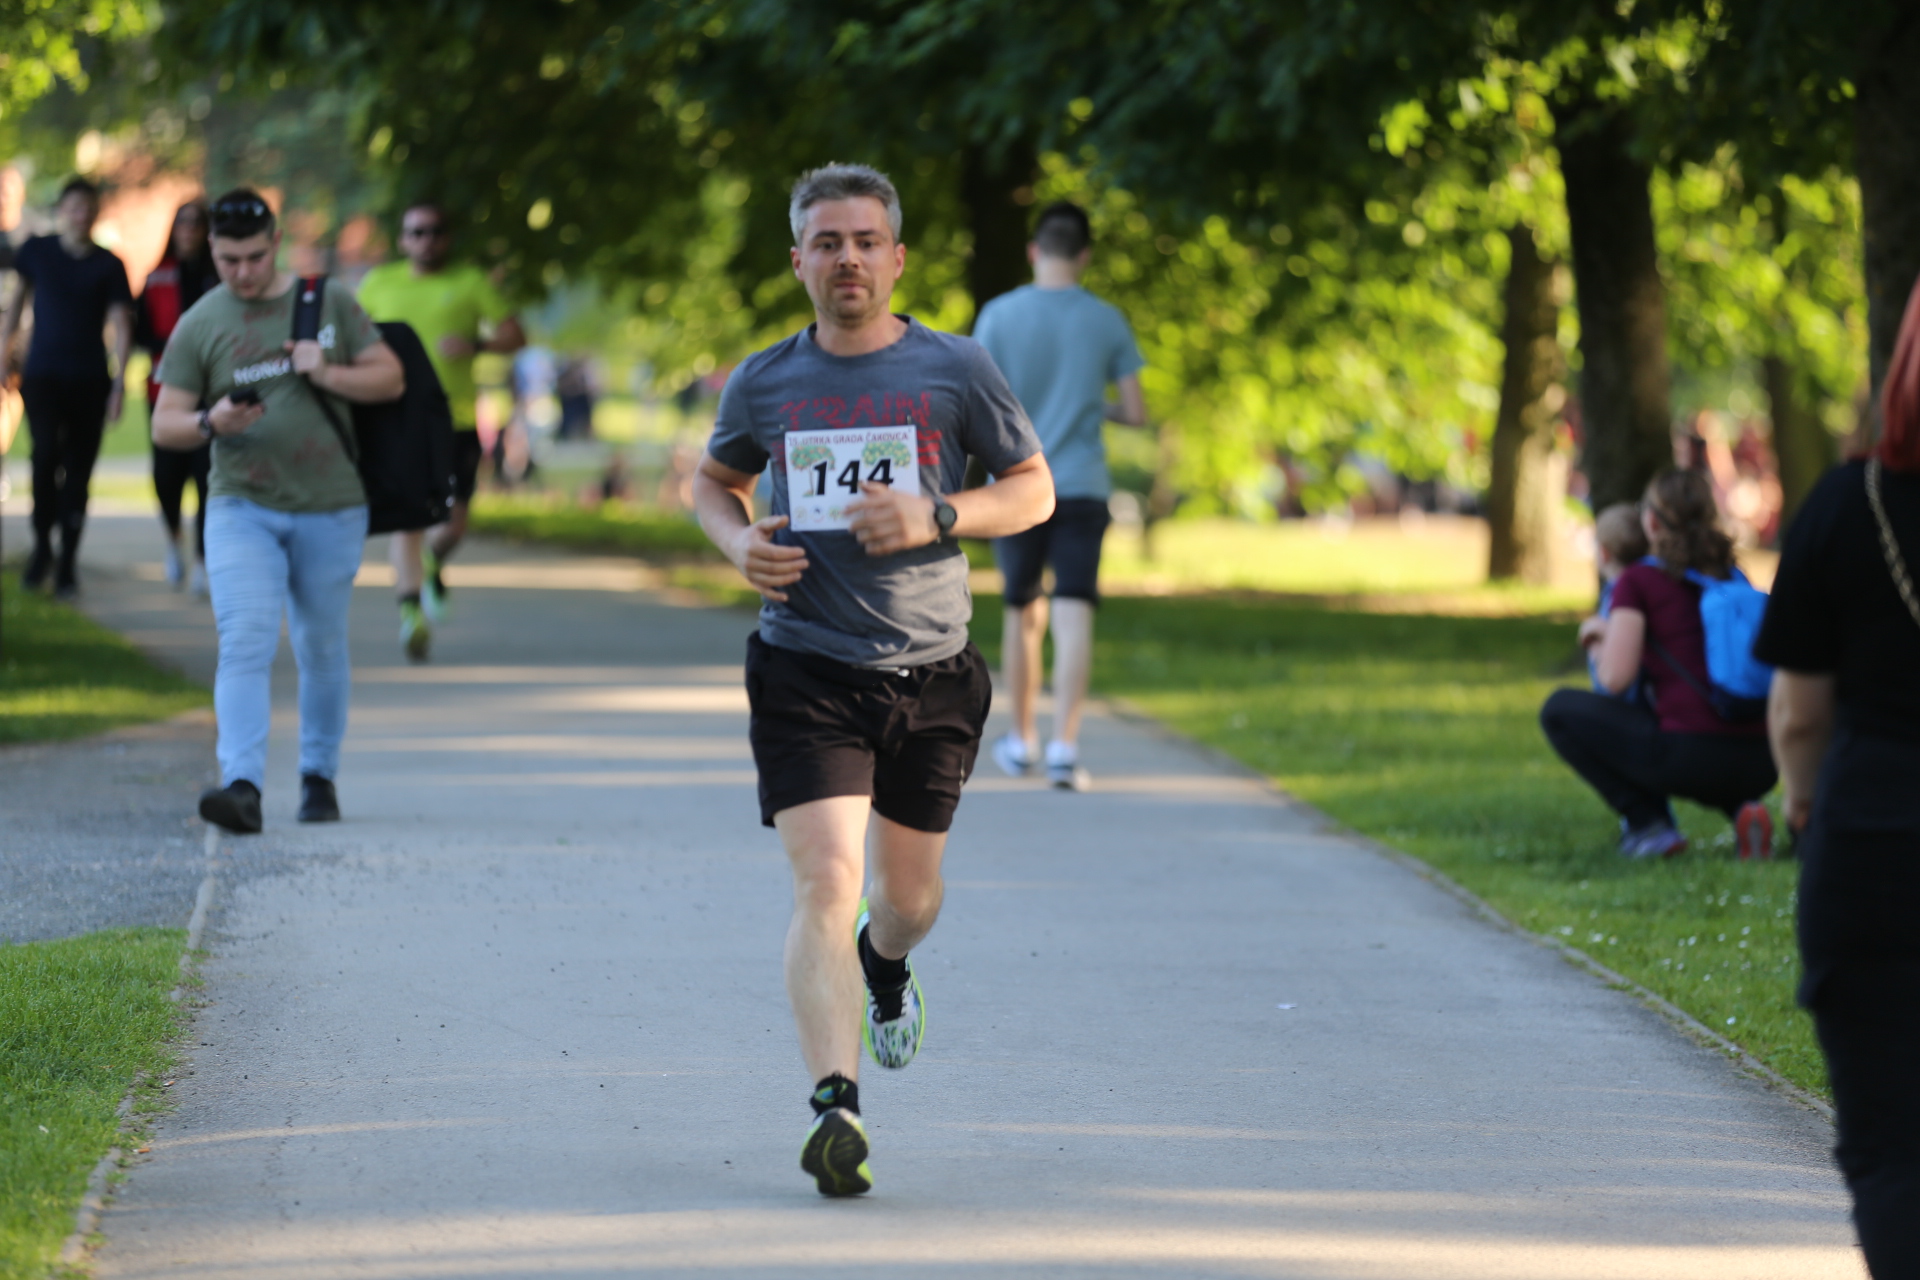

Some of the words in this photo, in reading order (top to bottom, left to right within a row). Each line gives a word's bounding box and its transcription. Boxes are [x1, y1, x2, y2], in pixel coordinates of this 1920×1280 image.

[802, 435, 830, 446] UTRKA
[832, 433, 863, 444] GRADA
[865, 431, 909, 443] ČAKOVCA
[813, 458, 894, 495] 144
